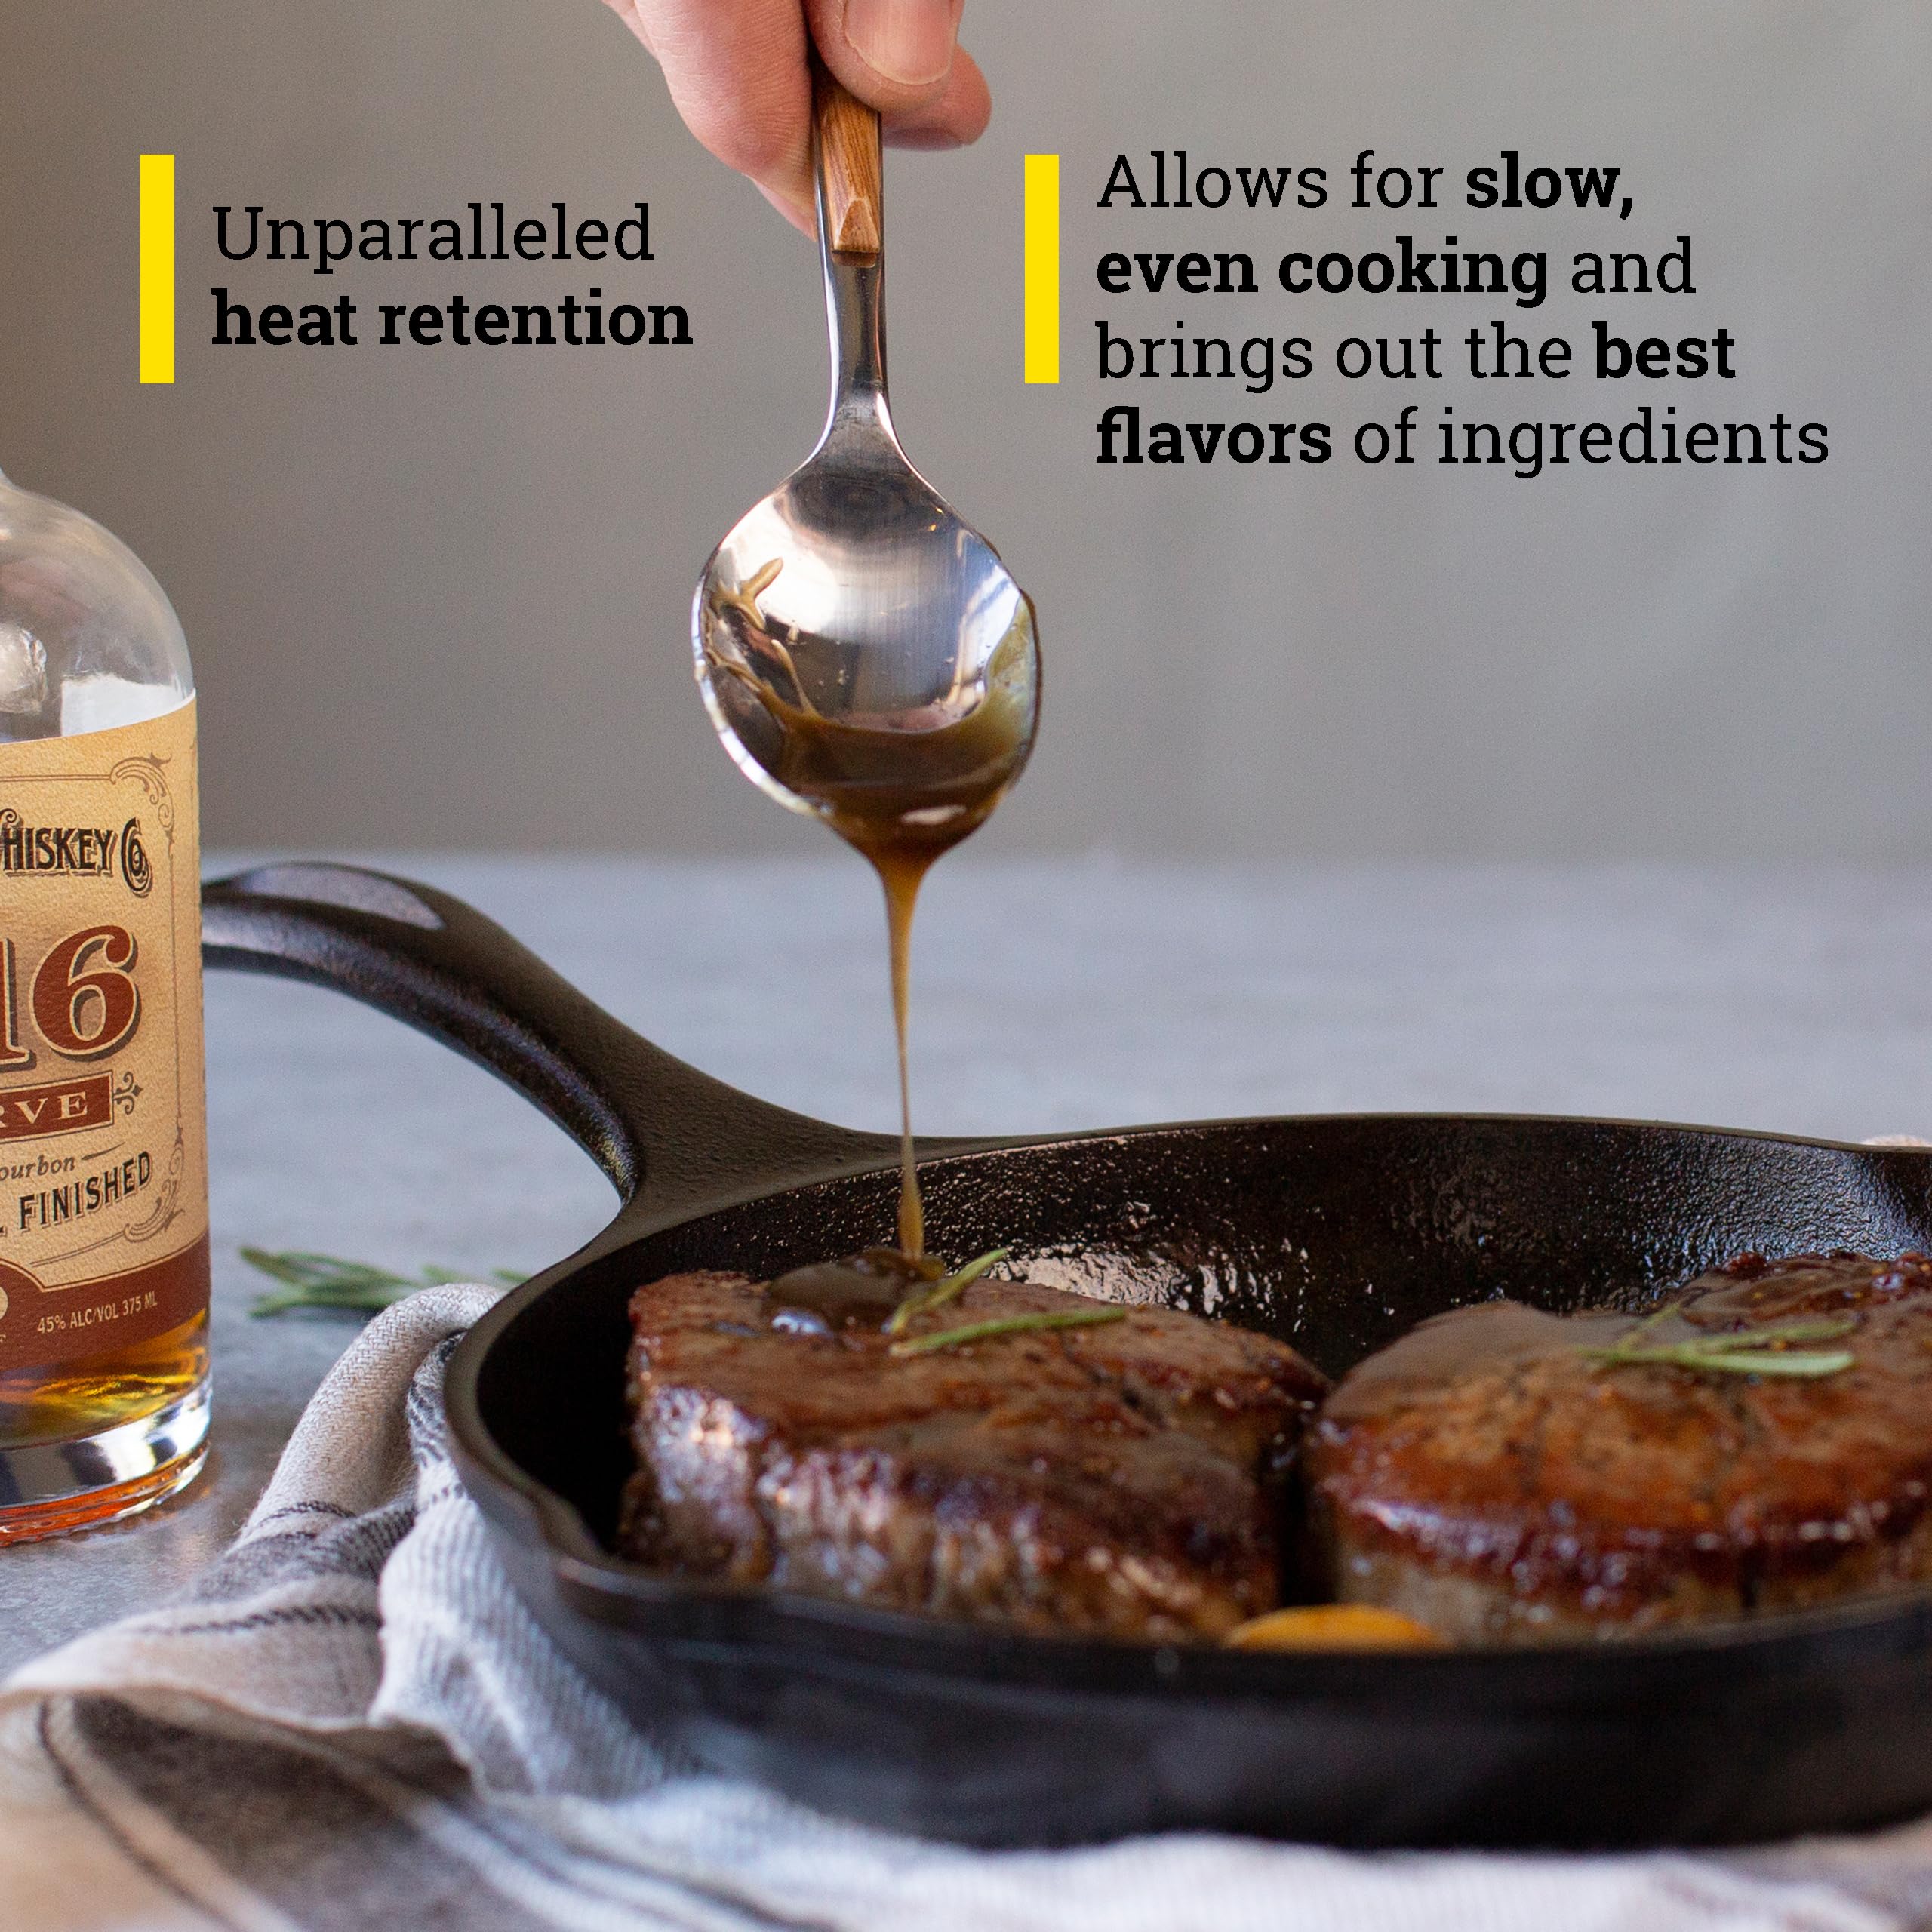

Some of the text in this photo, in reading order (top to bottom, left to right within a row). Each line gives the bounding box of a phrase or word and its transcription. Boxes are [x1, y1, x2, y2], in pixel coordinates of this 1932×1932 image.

[0, 808, 118, 877] HISKEY
[0, 1091, 88, 1128] VE
[20, 1151, 152, 1233] FINISHED
[37, 1291, 158, 1334] 45% ALC/VOL 375 ML
